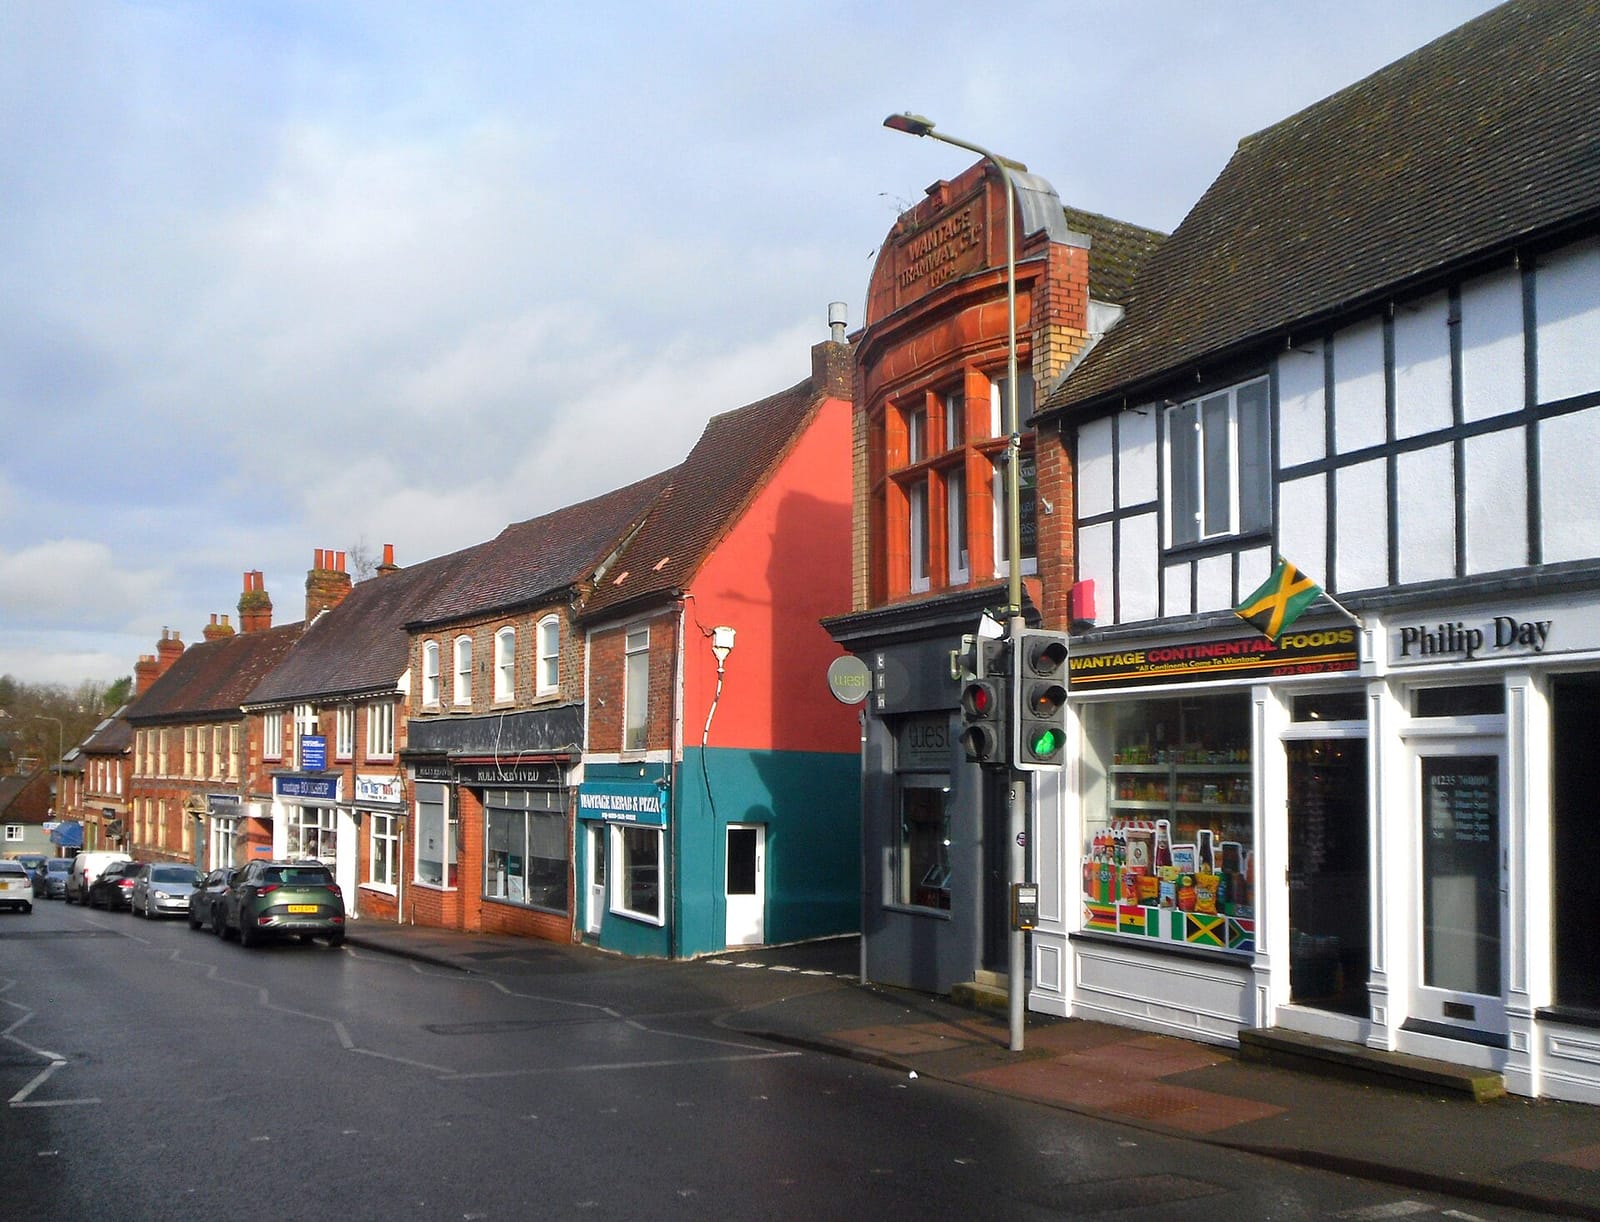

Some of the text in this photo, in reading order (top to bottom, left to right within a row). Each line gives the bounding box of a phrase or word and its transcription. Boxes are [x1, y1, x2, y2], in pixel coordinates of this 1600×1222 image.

[908, 208, 971, 260] WANTAGE
[1070, 630, 1355, 670] WANTAGE CONTINENTAL FOODS
[1400, 615, 1553, 660] Philip Day
[1150, 661, 1189, 672] Continents
[1189, 659, 1211, 668] Come
[1212, 658, 1222, 666] To
[580, 794, 660, 813] WANTAGE KEBAB & PIZZA
